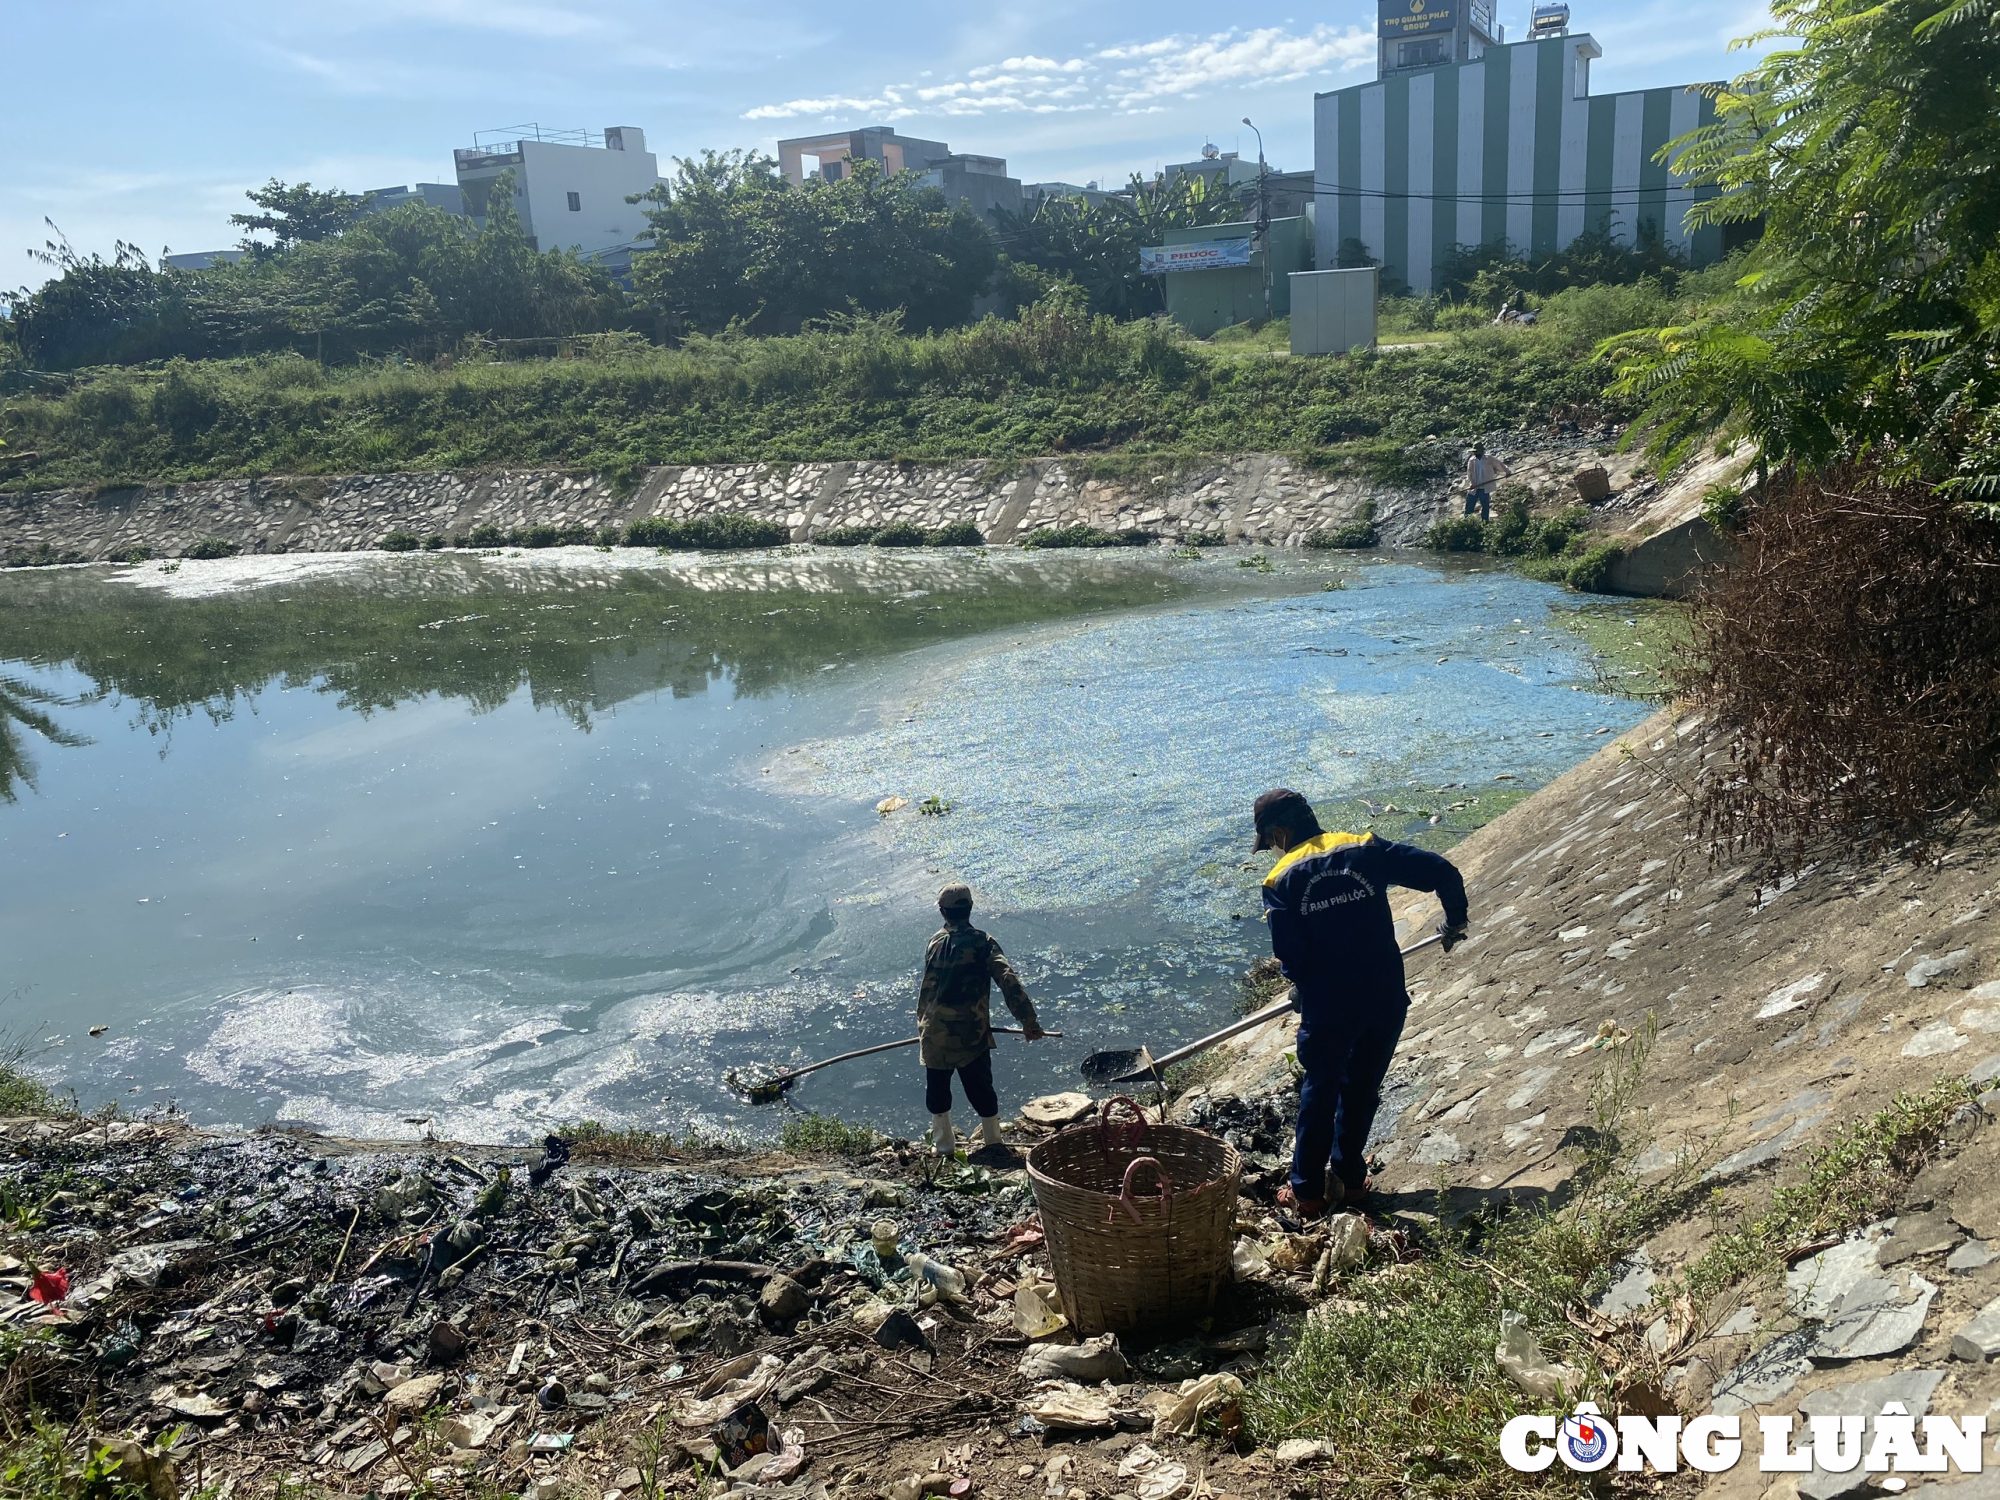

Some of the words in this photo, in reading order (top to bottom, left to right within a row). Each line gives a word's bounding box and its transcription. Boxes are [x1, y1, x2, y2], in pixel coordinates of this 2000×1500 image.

[1384, 17, 1400, 26] THỌ
[1402, 14, 1427, 23] QUANG
[1428, 9, 1450, 20] PHÁT
[1403, 22, 1429, 31] GROUP
[1171, 250, 1218, 259] PHƯỚC
[1309, 899, 1330, 912] RẠM
[1330, 892, 1347, 905] PHÚ
[1348, 889, 1366, 901] LỘC
